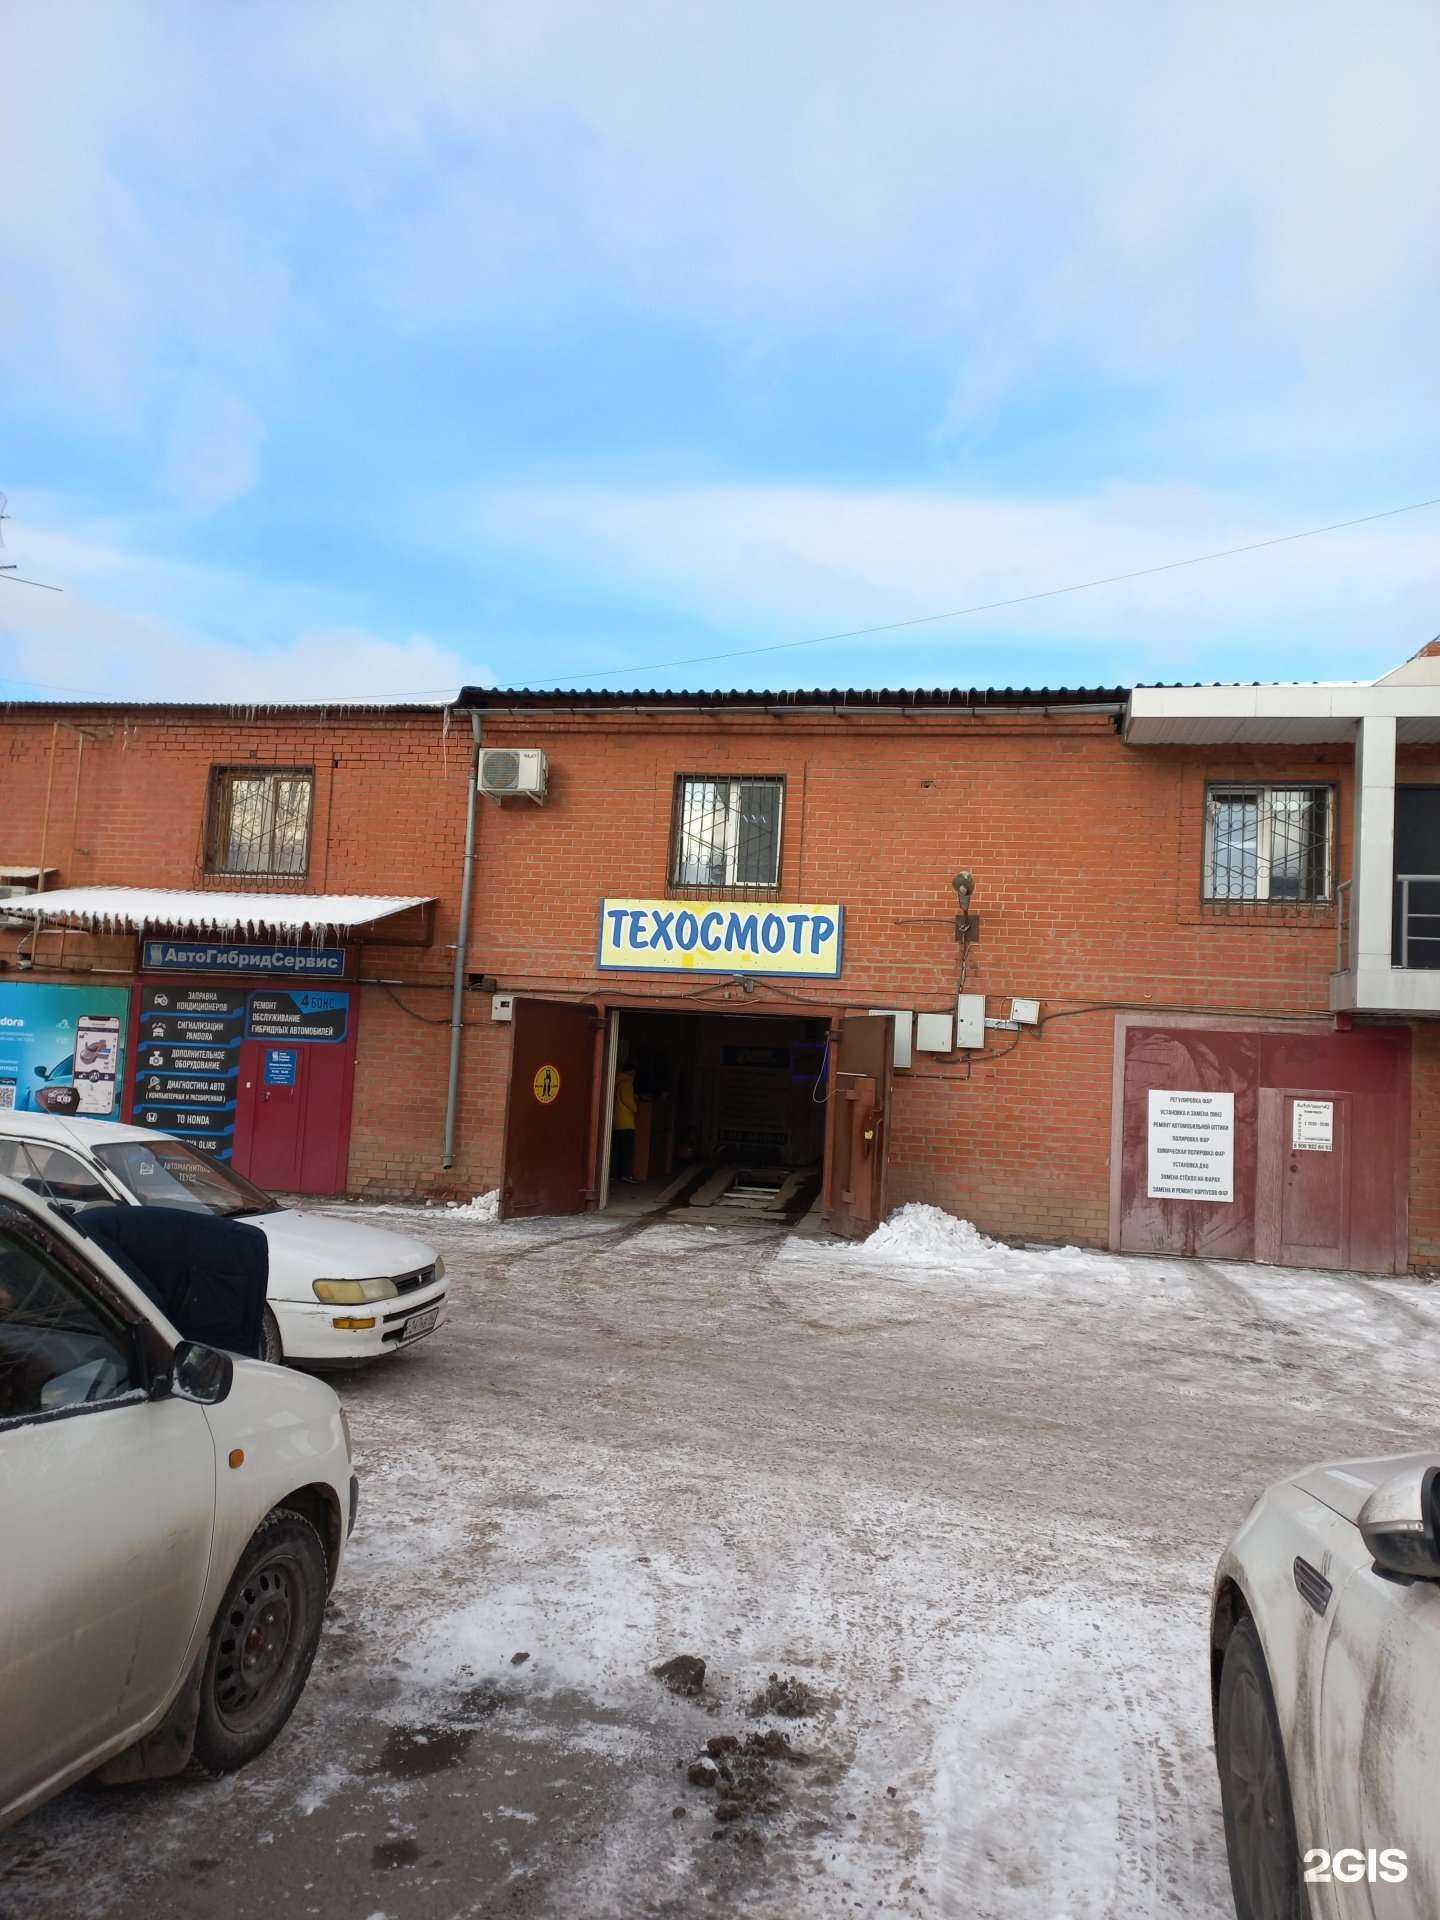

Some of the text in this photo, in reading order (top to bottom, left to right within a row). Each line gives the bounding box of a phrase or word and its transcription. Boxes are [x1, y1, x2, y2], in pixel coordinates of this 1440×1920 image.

[607, 909, 835, 955] ТЕХОСМОТР
[165, 948, 338, 969] АвтоГибридСервис
[188, 992, 218, 1002] ЗАПРАВКА
[176, 1003, 228, 1012] КОНДИЦИОНЕРОВ
[253, 1001, 277, 1010] РЕМОНТ
[252, 1013, 301, 1023] ОБСЛУЖИВАНИЕ
[177, 1021, 224, 1031] СИГНАЛИЗАЦИИ
[251, 1024, 333, 1036] ГИБРИДНЫХ АВТОМОБИЛЕЙ
[186, 1032, 213, 1042] PANDORA
[171, 1049, 225, 1060] ДОПОЛНИТЕЛЬНОЕ
[174, 1060, 220, 1071] ОБОРУДОВАНИЕ
[166, 1080, 225, 1091] ДИАГНОСТИКА АВТО
[187, 1114, 210, 1125] HONDA
[1171, 1122, 1210, 1130] АВТОМОБИЛЬНОЙ
[1172, 1161, 1198, 1169] УСТАНОВКА
